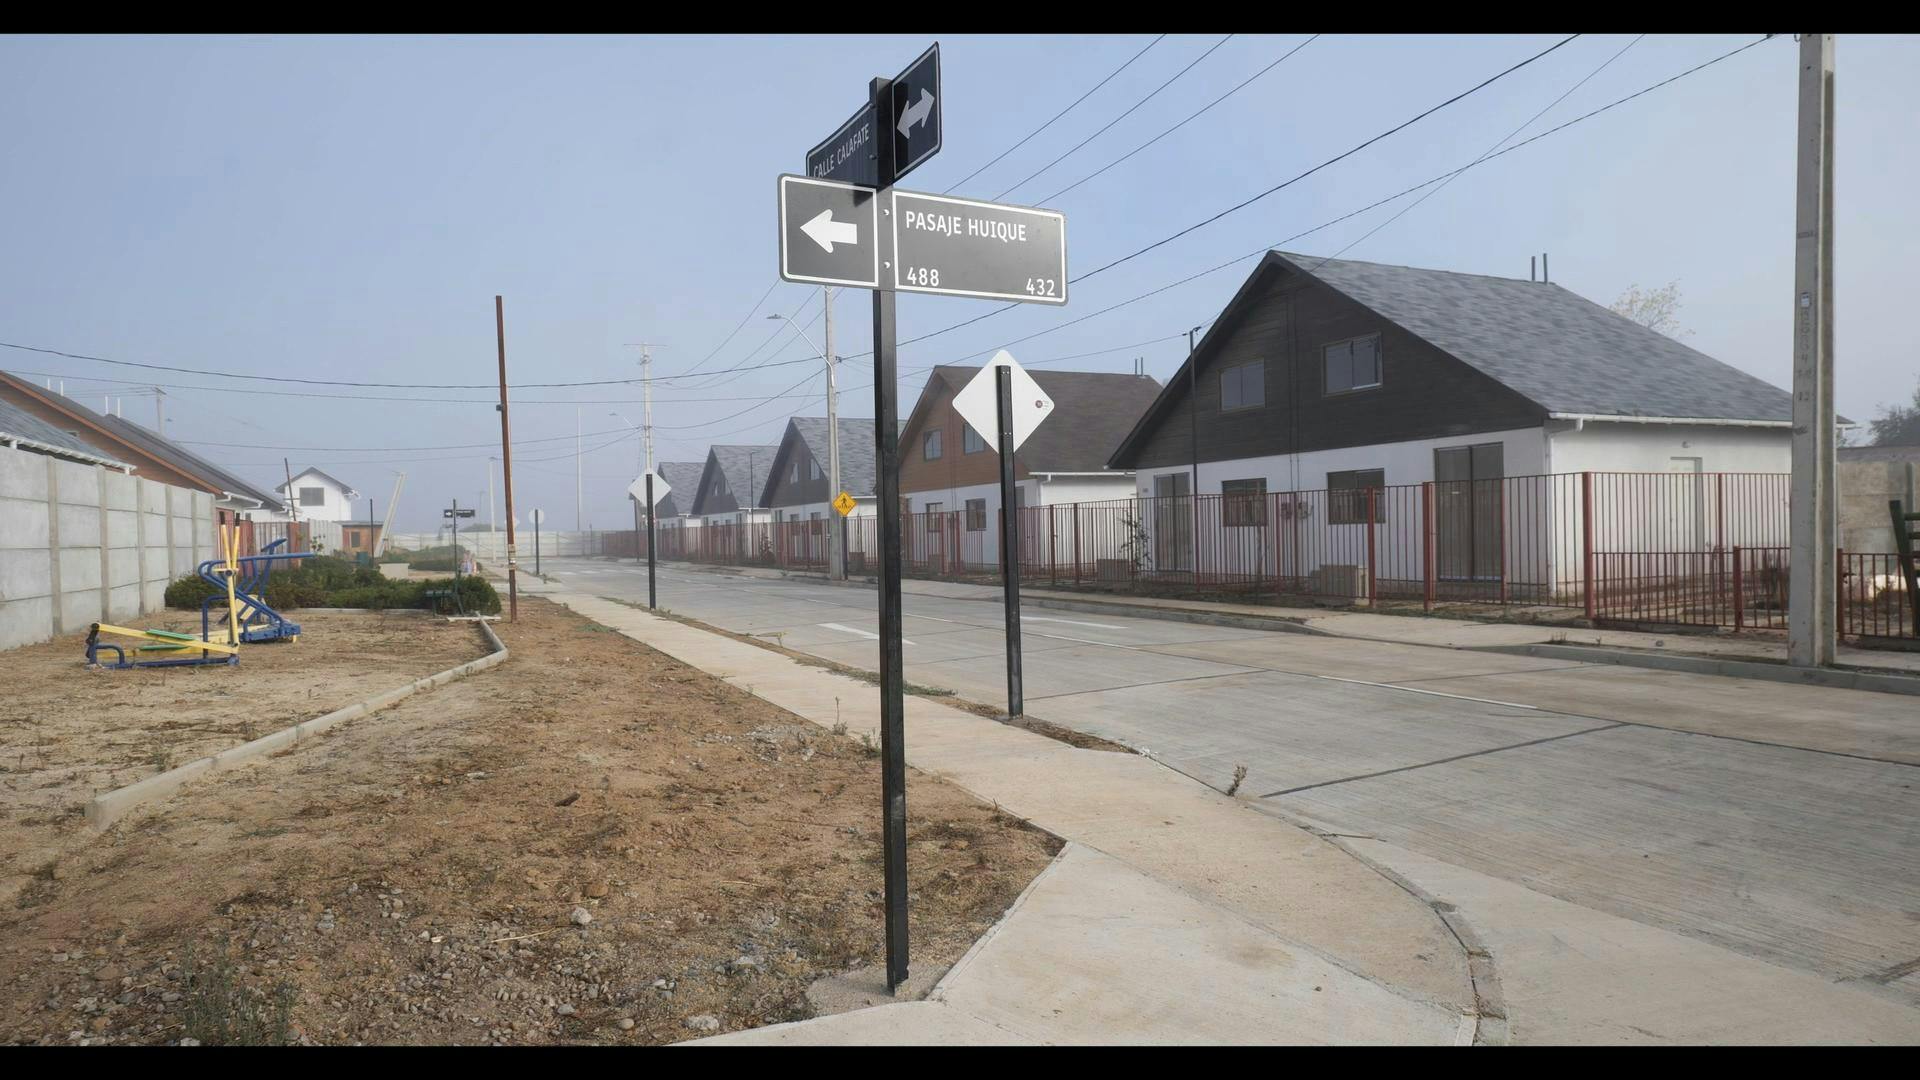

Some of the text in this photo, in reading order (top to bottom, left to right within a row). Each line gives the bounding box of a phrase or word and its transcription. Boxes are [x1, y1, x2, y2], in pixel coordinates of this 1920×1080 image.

[813, 122, 870, 178] CALLE CALAFATE
[905, 210, 1027, 243] PASAJE HUIQUE
[906, 266, 1056, 297] 488 432
